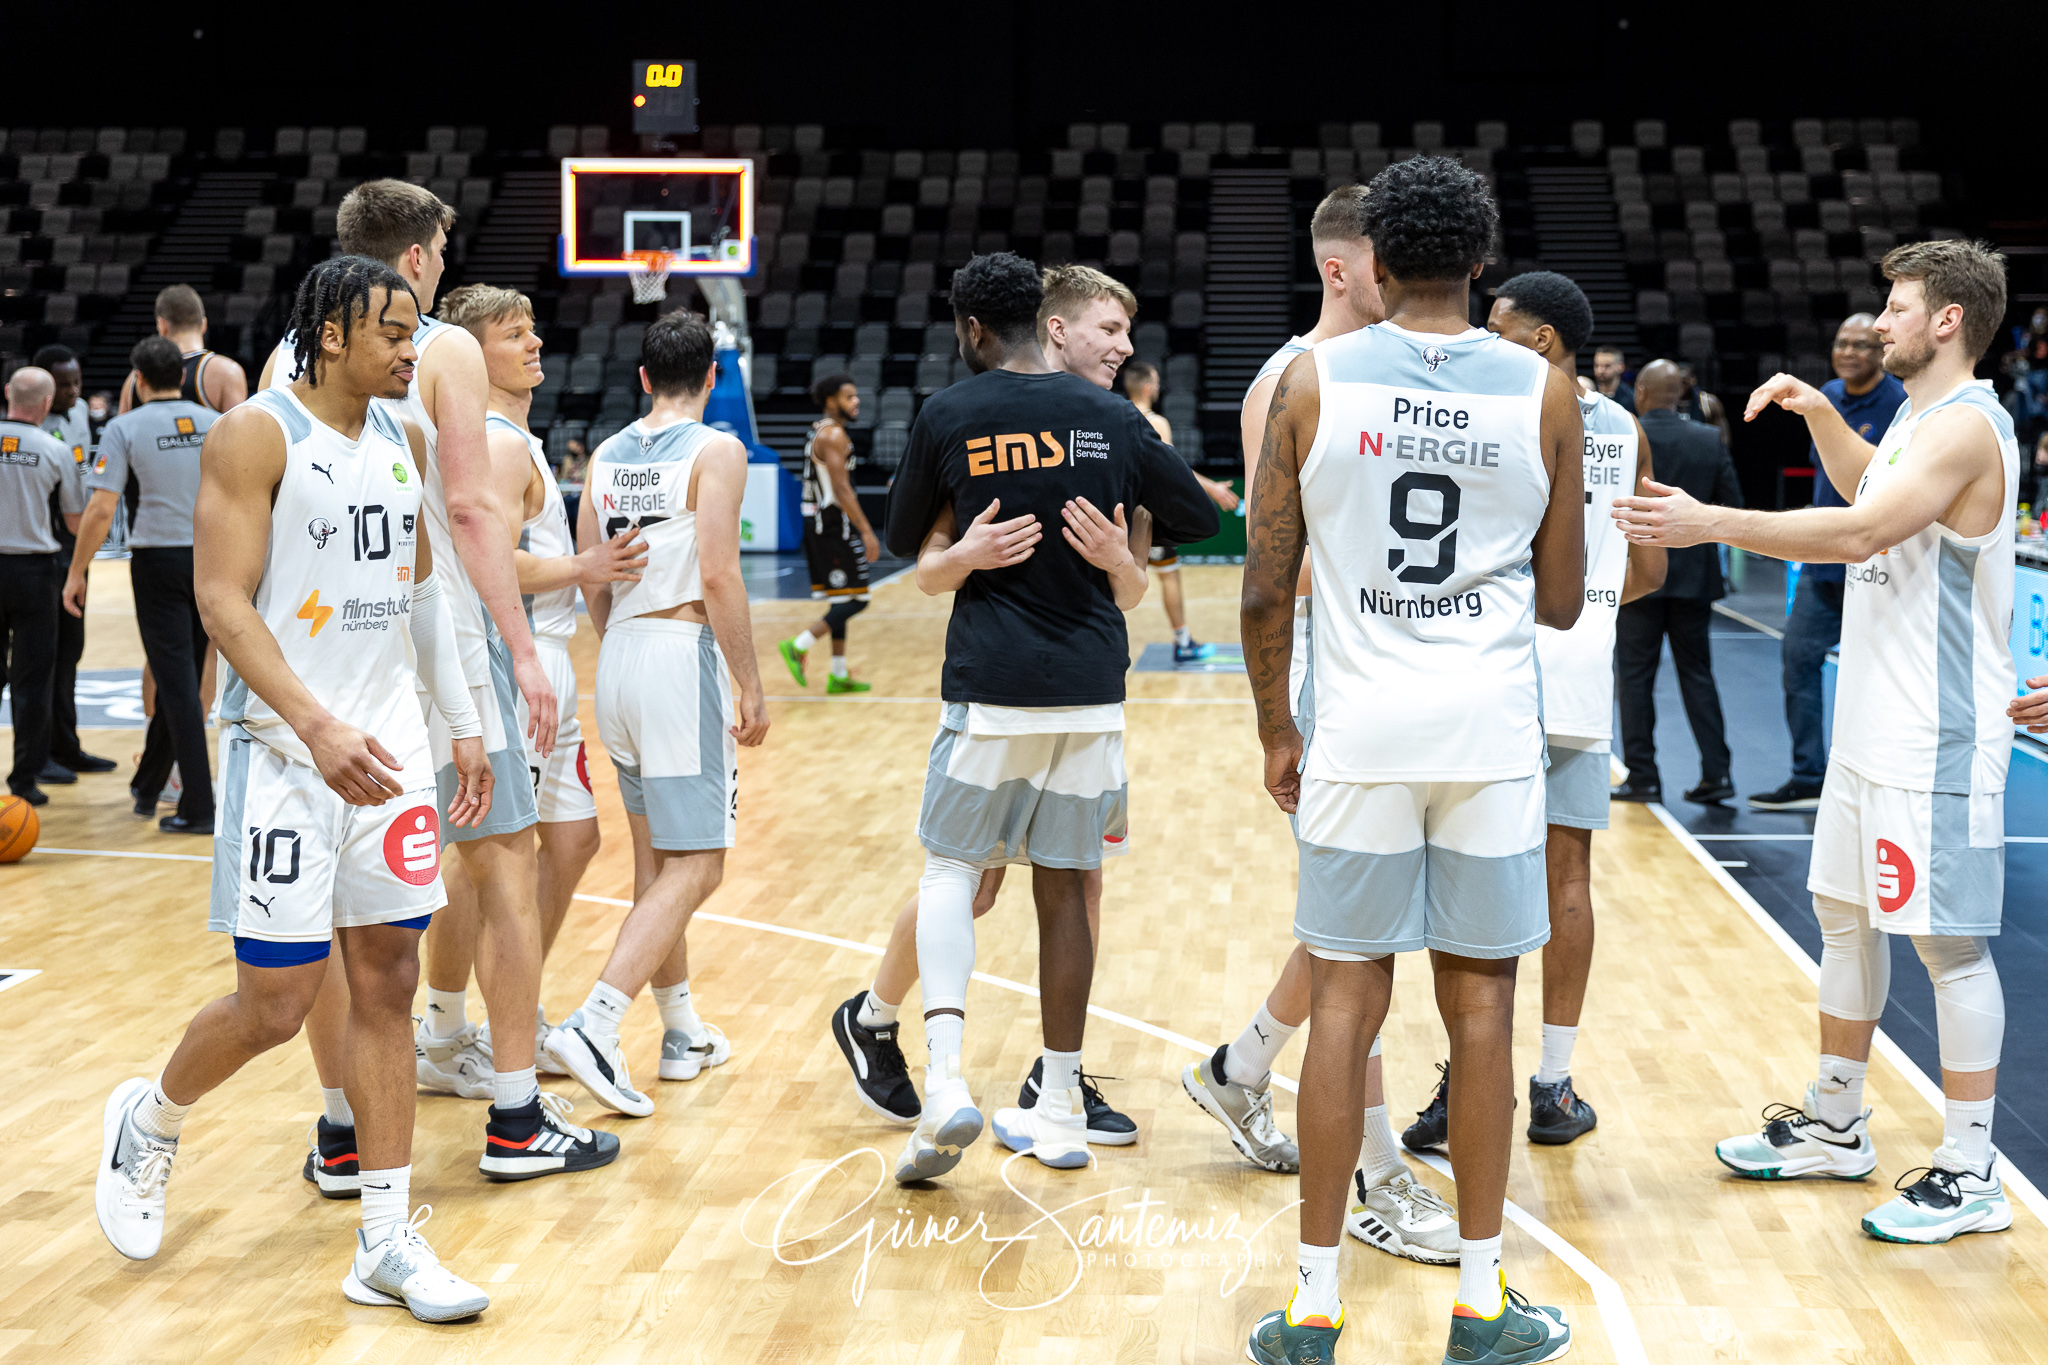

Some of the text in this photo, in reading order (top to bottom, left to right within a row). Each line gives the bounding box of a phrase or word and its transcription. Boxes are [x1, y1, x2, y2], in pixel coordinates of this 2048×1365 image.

[645, 63, 684, 88] 0.0
[1393, 397, 1469, 430] Price
[1076, 429, 1104, 440] Experts
[1076, 439, 1110, 451] Managed
[966, 431, 1065, 476] EMS
[1075, 449, 1108, 460] Services
[612, 468, 661, 491] Köpple
[348, 504, 391, 562] 10
[1387, 471, 1462, 585] 9
[1360, 587, 1483, 619] Nürnberg
[341, 619, 389, 632] nürnberg
[249, 826, 302, 885] 10
